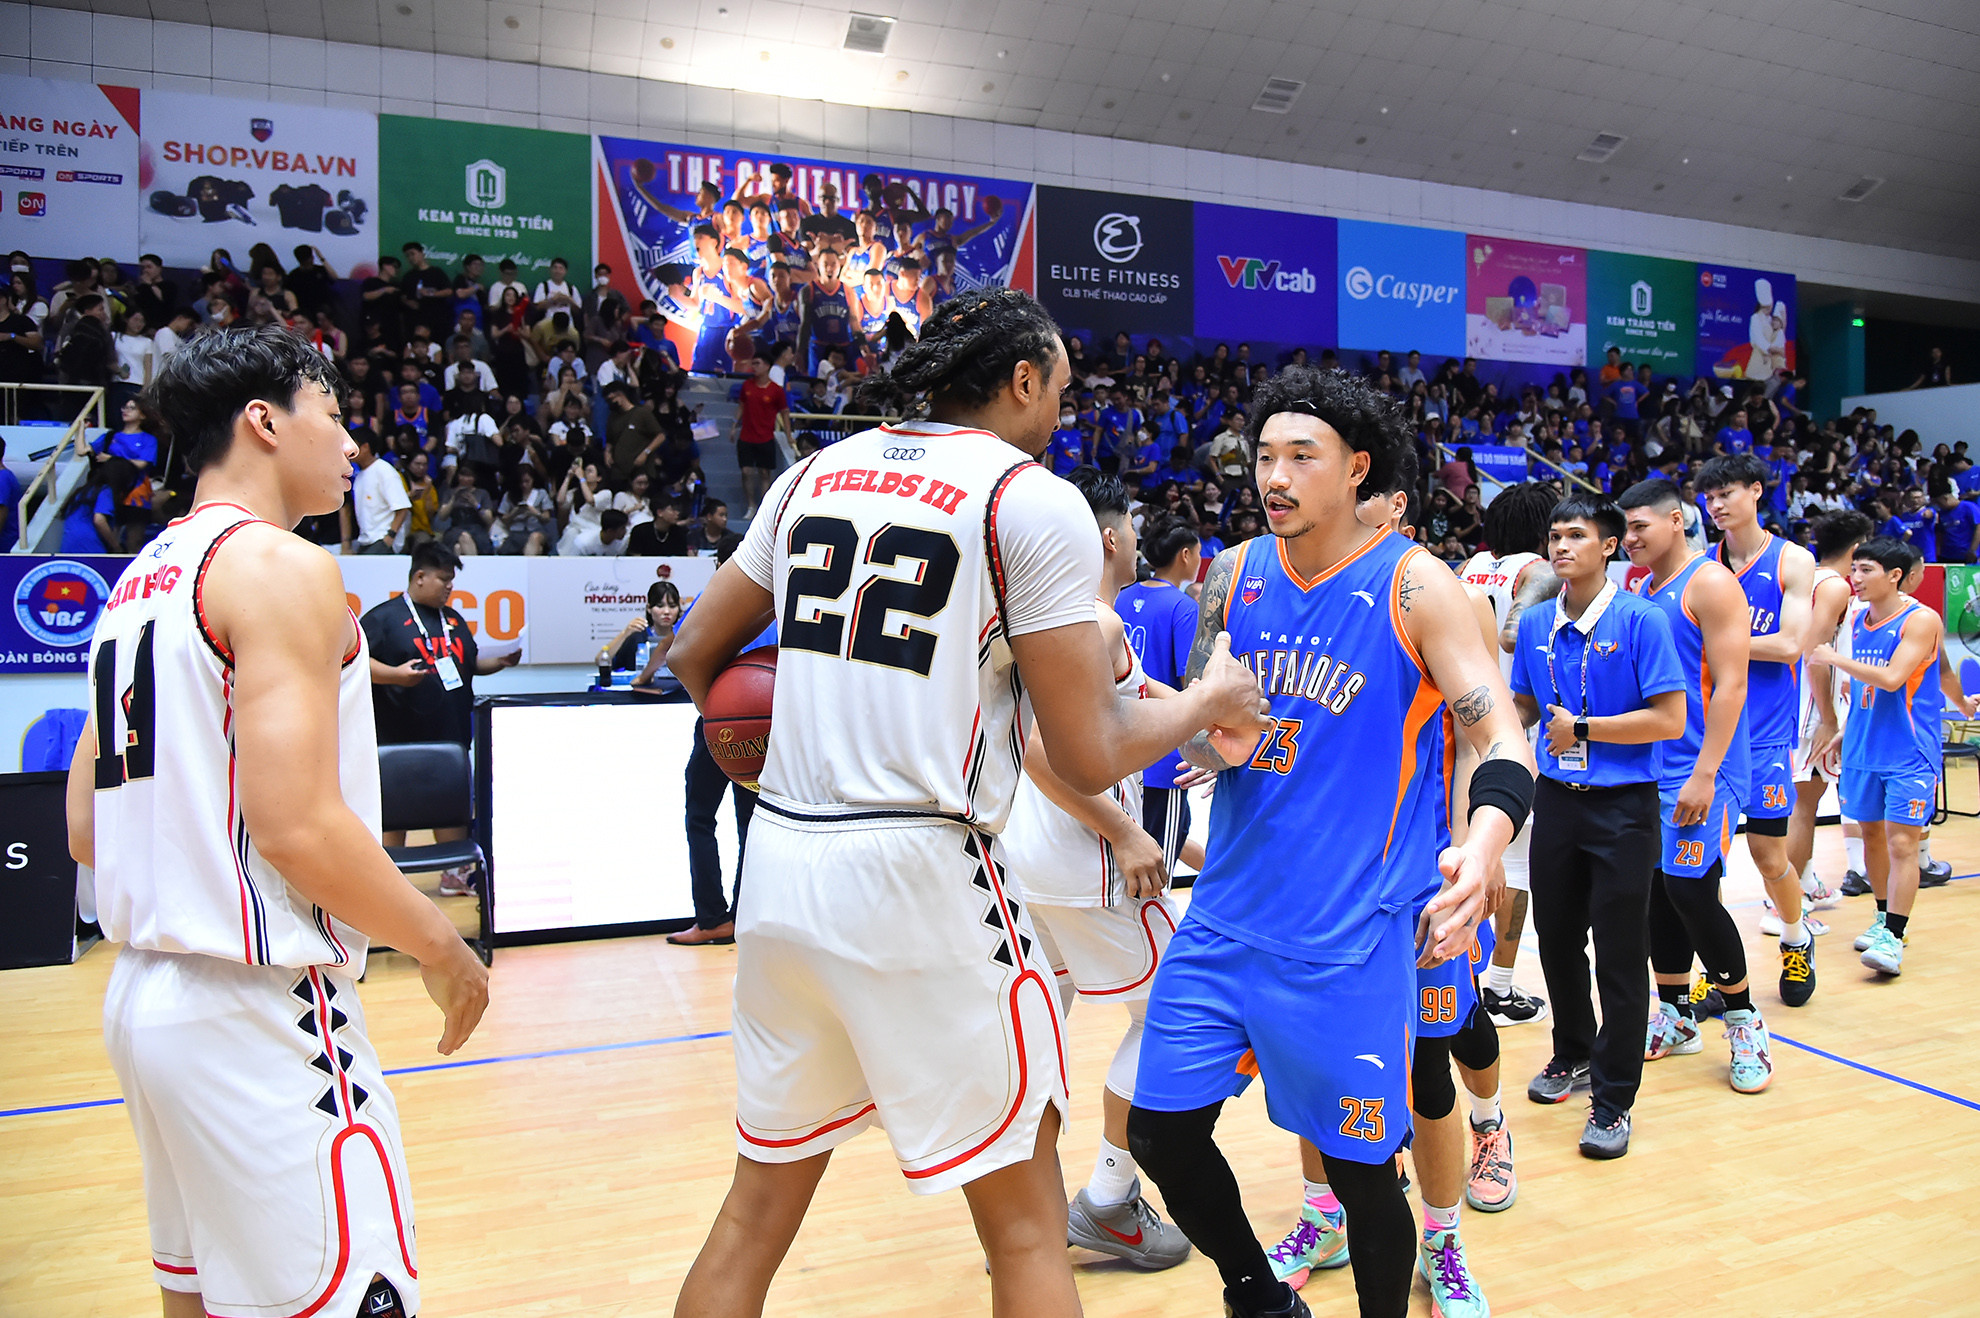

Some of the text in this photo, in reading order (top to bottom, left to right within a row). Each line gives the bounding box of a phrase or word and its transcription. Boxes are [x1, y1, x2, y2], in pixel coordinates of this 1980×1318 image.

[53, 119, 118, 139] NGÀY
[0, 138, 79, 158] IẾP TRÊN
[163, 141, 356, 177] SHOP.VBA.VN
[77, 173, 120, 183] SPORTS
[667, 153, 722, 194] THE
[736, 160, 860, 209] CAITAL
[418, 208, 454, 223] KEM
[455, 226, 490, 237] SINCE
[1051, 265, 1180, 289] ELITE FITNESS
[1062, 288, 1080, 298] CLB
[1102, 290, 1127, 301] THAO
[1129, 293, 1147, 303] CAO
[1376, 275, 1459, 308] Casper
[812, 469, 968, 515] FIELDS III
[584, 593, 647, 604] nhân sâm
[780, 513, 963, 679] 22
[39, 611, 86, 627] VBF
[33, 650, 77, 664] BÓNG
[1239, 650, 1366, 716] FFALOES
[1248, 714, 1303, 776] 23
[1762, 784, 1788, 808] 34
[1674, 839, 1704, 866] 29
[1420, 985, 1457, 1024] 99
[1339, 1096, 1385, 1143] 23
